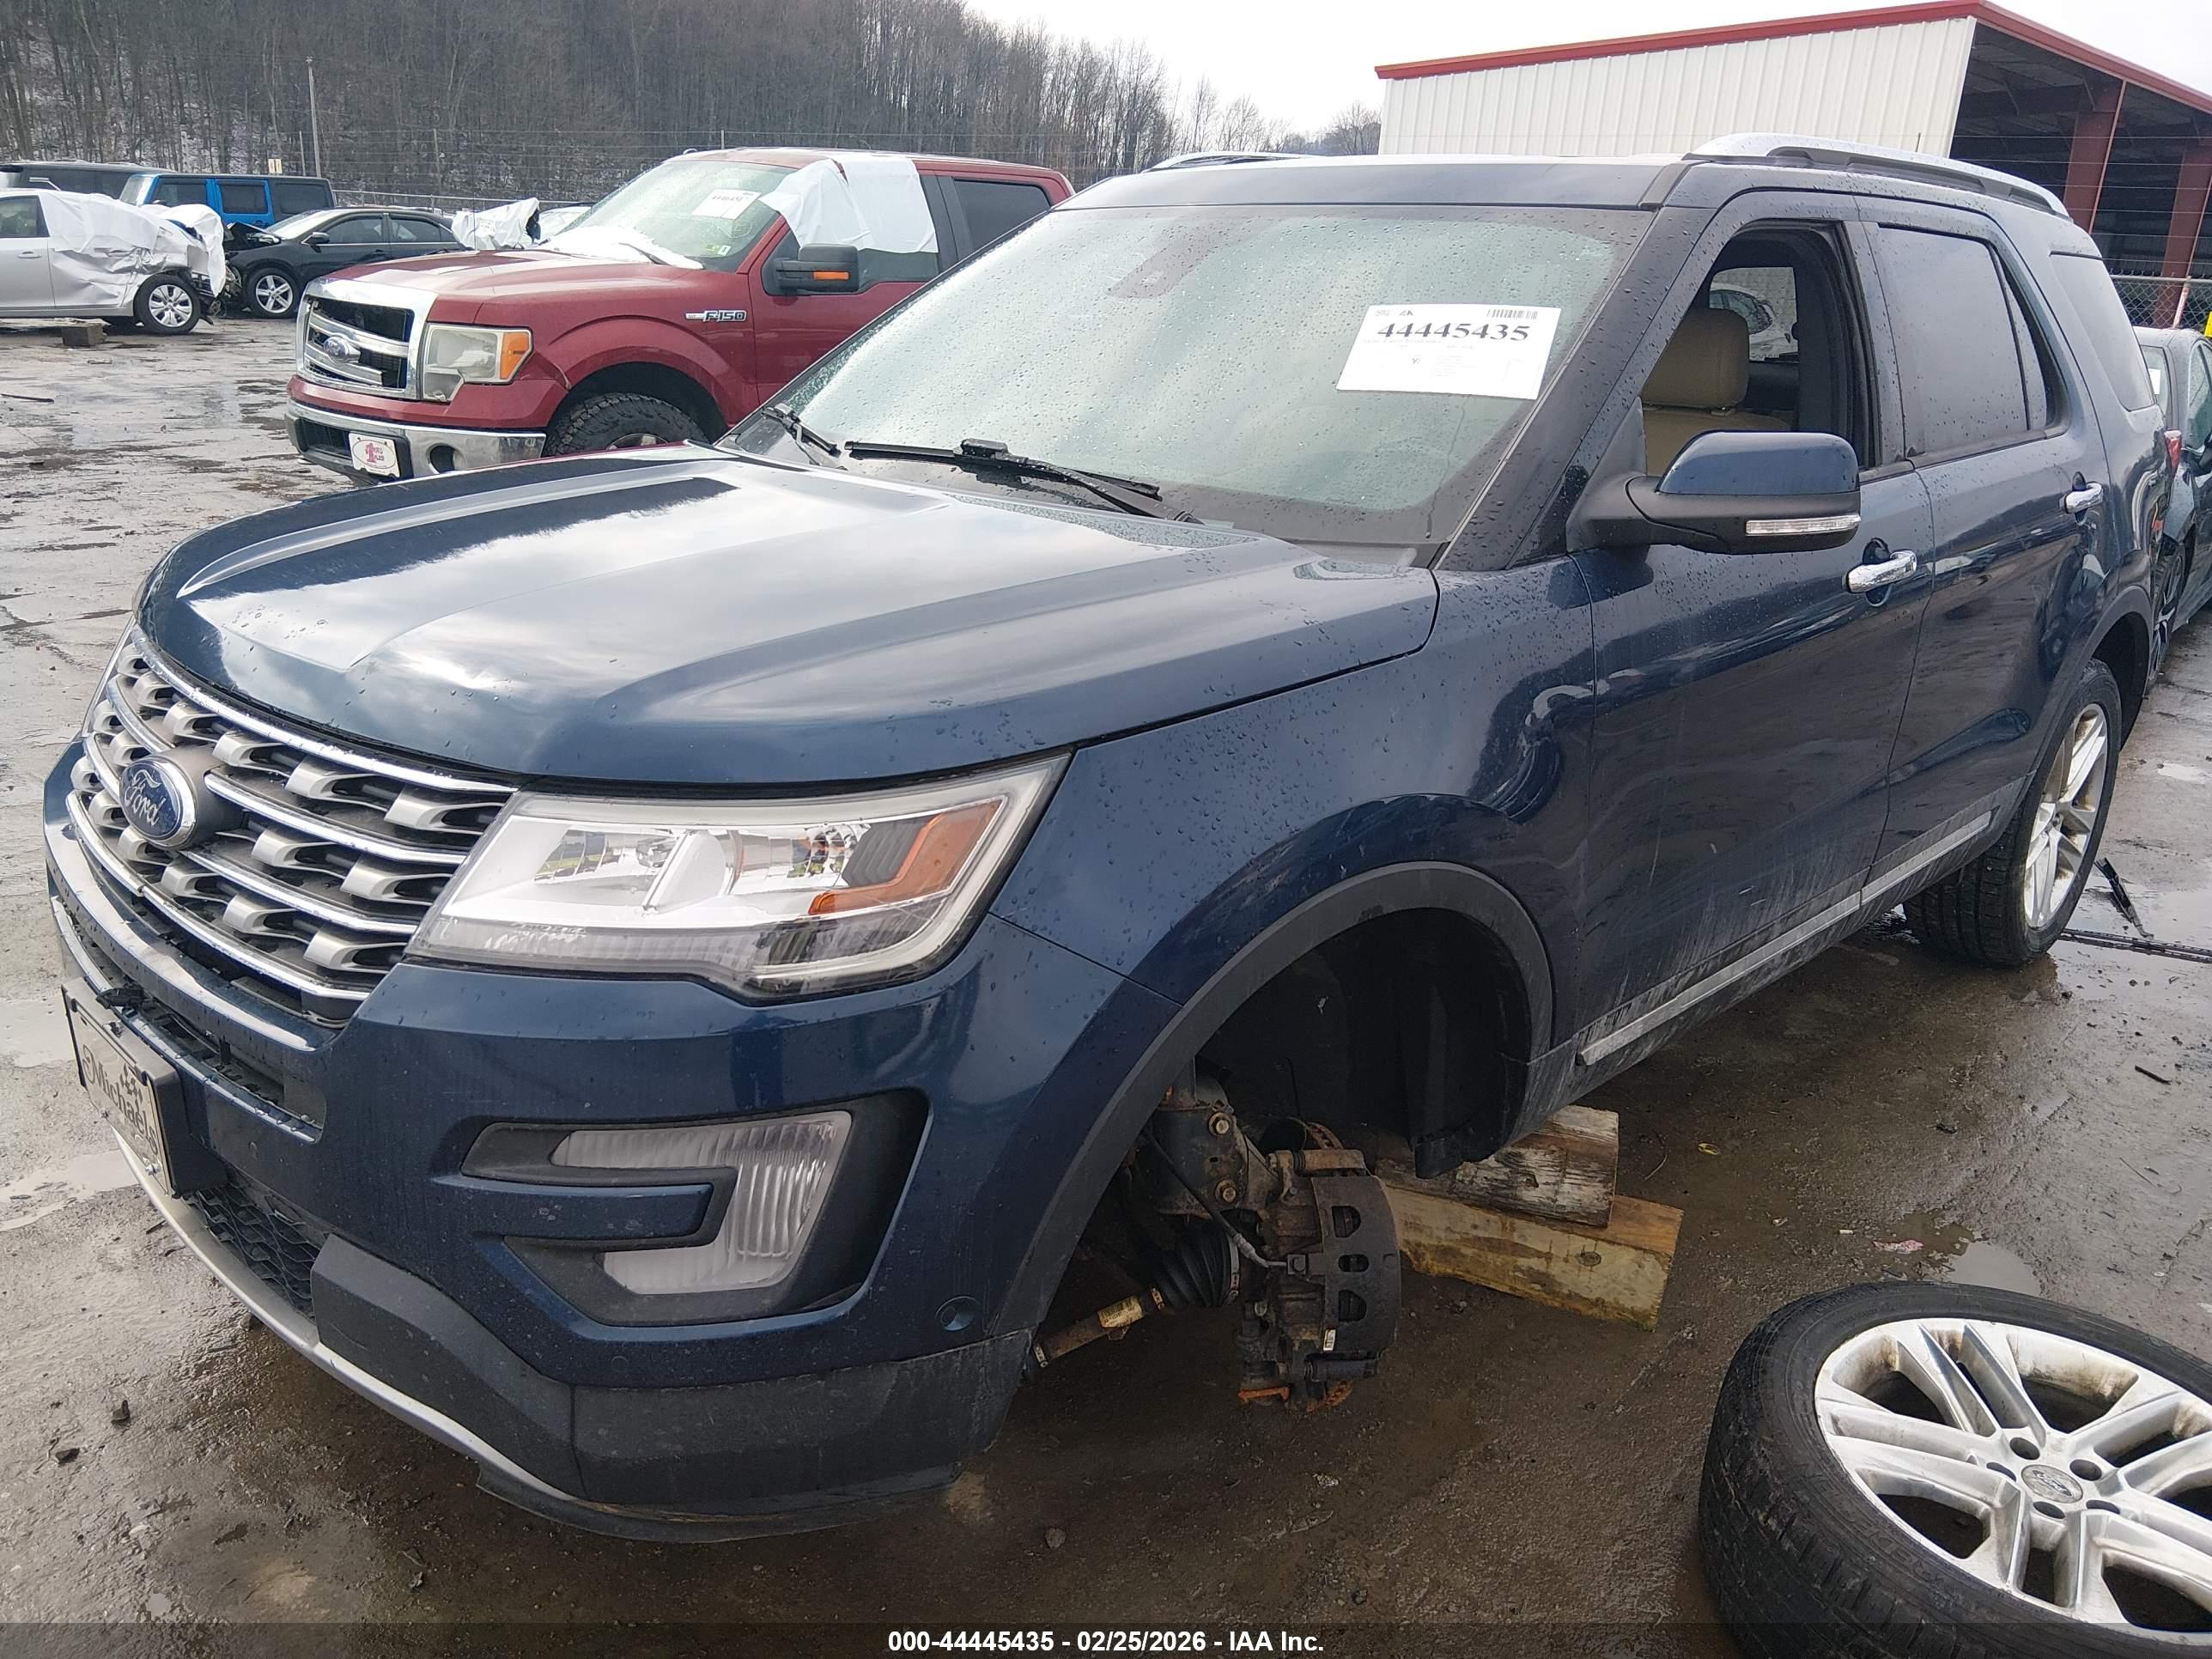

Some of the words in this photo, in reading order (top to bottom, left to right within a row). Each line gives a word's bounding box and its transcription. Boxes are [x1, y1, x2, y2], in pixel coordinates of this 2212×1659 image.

[704, 310, 746, 321] F-150
[1377, 322, 1531, 342] 44445435
[124, 769, 167, 828] Ford
[82, 1043, 158, 1155] Michaels
